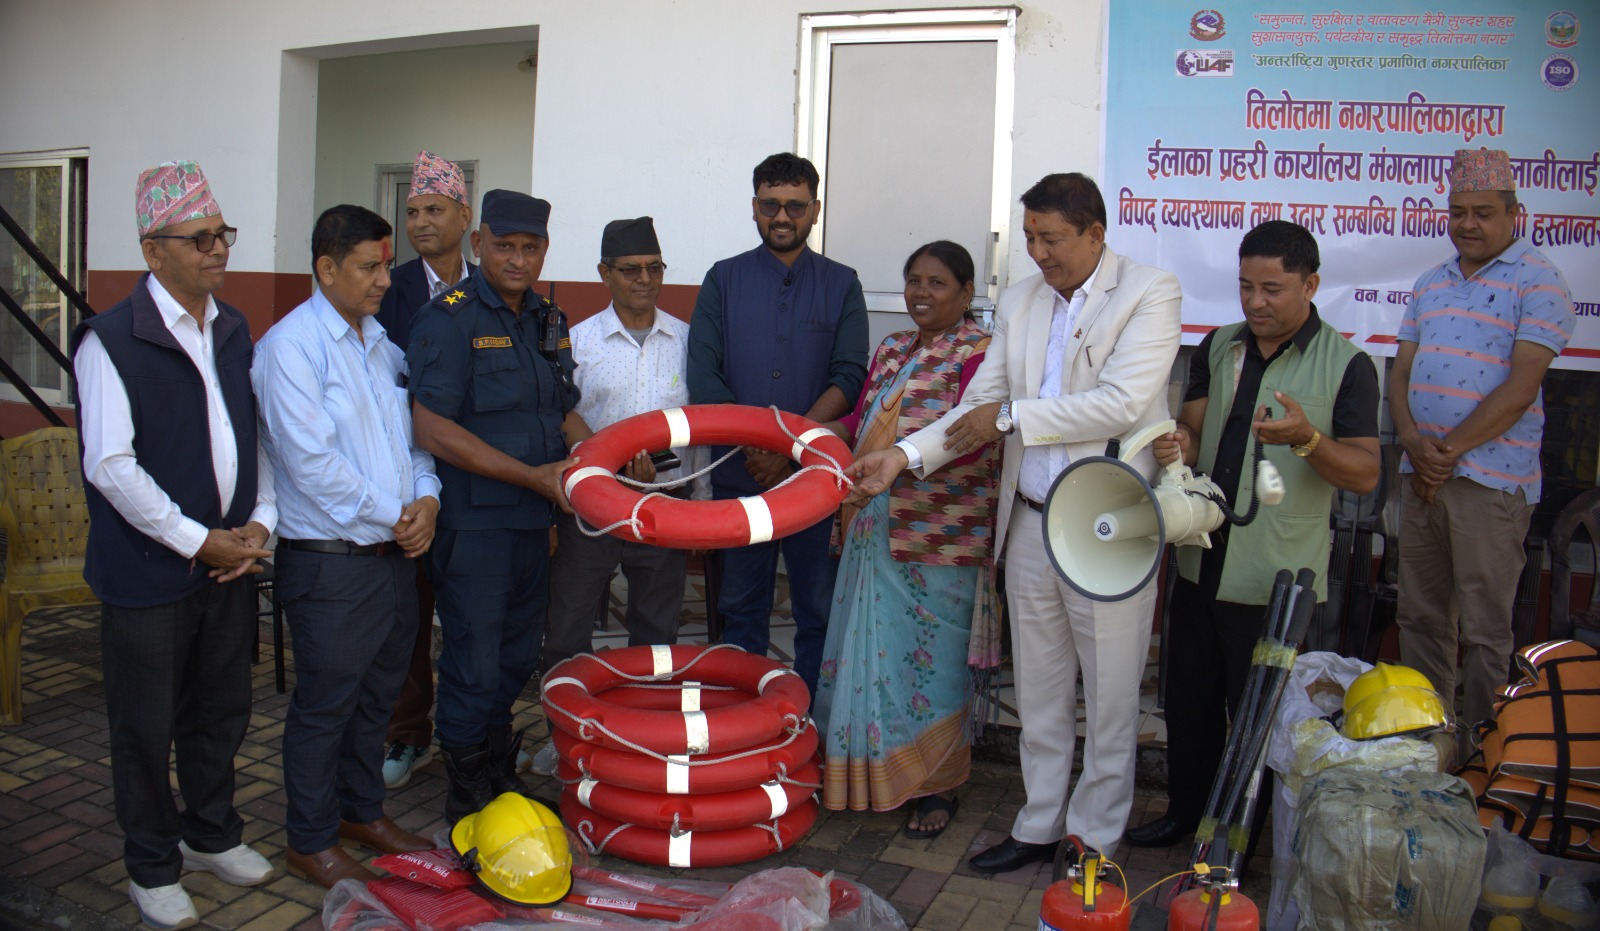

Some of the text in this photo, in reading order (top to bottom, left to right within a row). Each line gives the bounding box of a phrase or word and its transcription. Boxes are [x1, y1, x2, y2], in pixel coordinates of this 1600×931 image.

[1312, 10, 1353, 29] सुरक्षित
[1356, 15, 1365, 25] र
[1367, 15, 1420, 26] वातावरण
[1423, 11, 1446, 26] मैत्री
[1448, 15, 1485, 30] सुन्दर
[1487, 16, 1515, 28] शहर
[1325, 28, 1375, 43] पर्यटकीय
[1377, 32, 1386, 43] र
[1427, 28, 1478, 44] तिलोत्तमा
[1196, 59, 1233, 72] UAF
[1327, 56, 1375, 70] गुणस्तर
[1379, 54, 1427, 69] प्रमाणित
[1549, 66, 1571, 75] ISO
[1246, 88, 1506, 142] तिलोत्तमा नगरपालिकाद्वारा
[1147, 139, 1213, 181] ईलाका
[1219, 140, 1269, 182] प्रहरी
[1274, 143, 1363, 182] कार्यालय
[1118, 187, 1157, 233] विपद्
[1161, 198, 1246, 231] व्यवस्थापन
[1333, 195, 1397, 237] सम्बन्धि
[1532, 213, 1600, 248] हस्तान्त
[396, 853, 432, 870] BLANKET
[431, 866, 450, 878] FIRE
